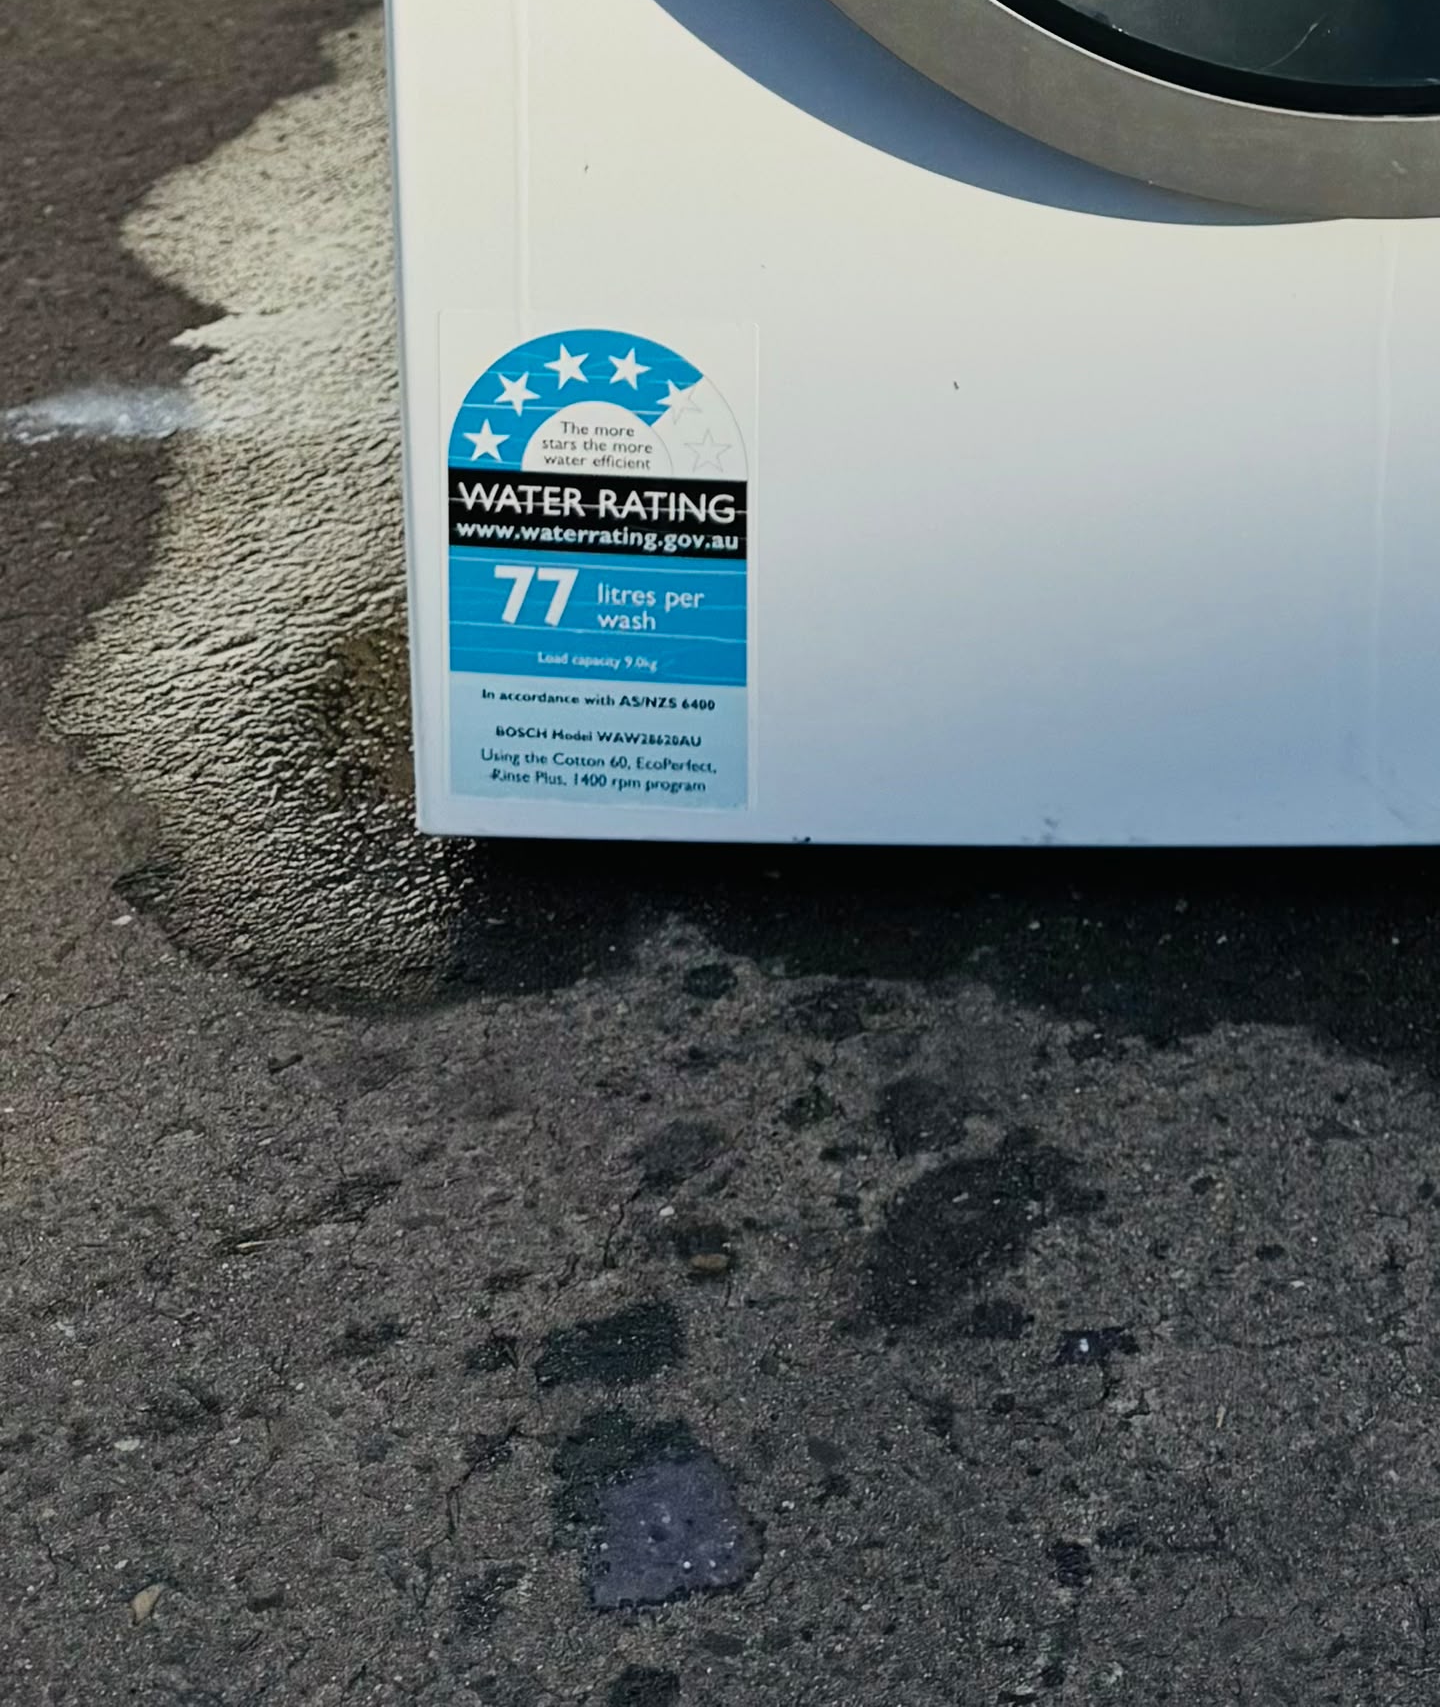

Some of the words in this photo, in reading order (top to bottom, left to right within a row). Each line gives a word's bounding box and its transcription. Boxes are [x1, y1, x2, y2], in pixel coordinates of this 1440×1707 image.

[561, 421, 588, 436] The
[595, 426, 634, 437] more
[542, 439, 576, 451] stars
[584, 440, 606, 452] the
[613, 443, 652, 454] more
[544, 455, 586, 467] water
[593, 456, 650, 470] efficient
[458, 482, 585, 518] WATER
[599, 489, 735, 524] RATING
[457, 522, 738, 551] www.waterrating.gov.au
[494, 565, 579, 627] 77
[598, 583, 656, 606] litres
[665, 590, 704, 612] per
[598, 612, 656, 630] wash
[538, 652, 568, 664] Load
[482, 689, 495, 699] In
[500, 692, 579, 704] accordance
[585, 694, 615, 706] with
[619, 696, 677, 709] AS/NZS
[682, 698, 715, 710] 6400
[496, 726, 547, 739] BOSCH
[481, 748, 520, 766] Using
[525, 752, 547, 764] the
[553, 753, 604, 767] Cotton
[492, 768, 529, 783] Rinse
[574, 772, 606, 786] 1400
[612, 778, 641, 792] rpm
[646, 779, 705, 795] program
